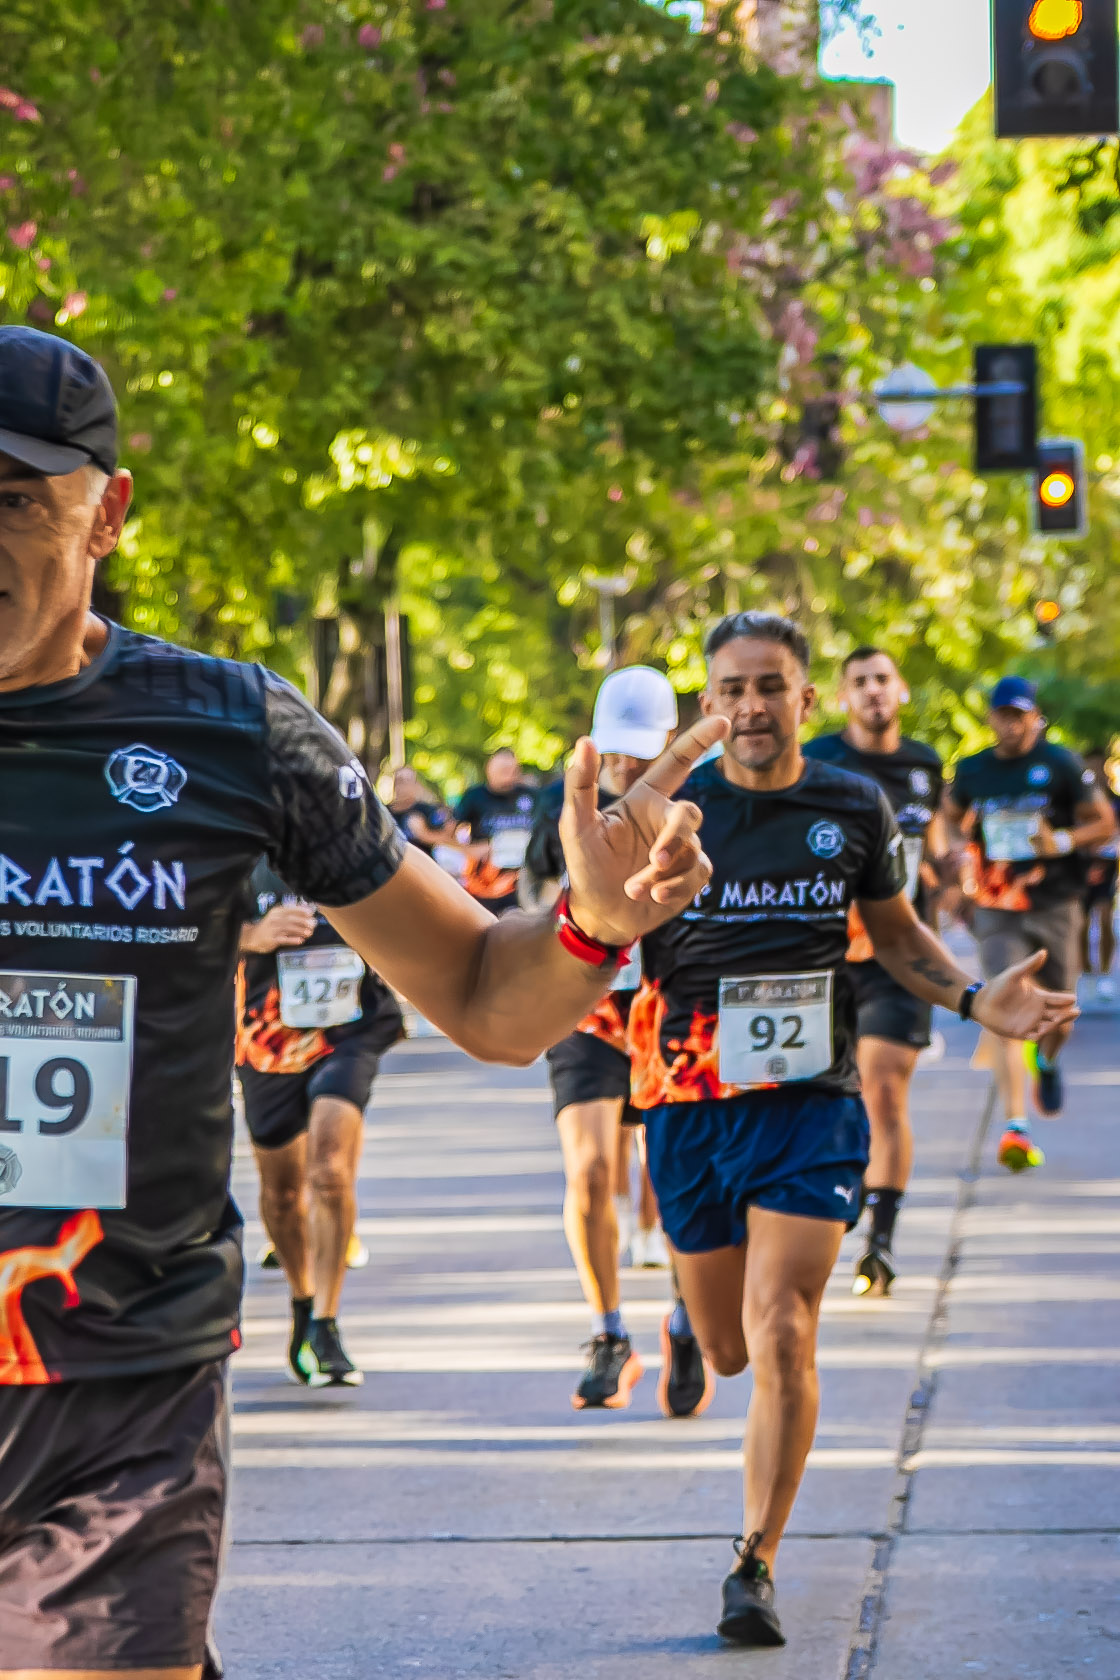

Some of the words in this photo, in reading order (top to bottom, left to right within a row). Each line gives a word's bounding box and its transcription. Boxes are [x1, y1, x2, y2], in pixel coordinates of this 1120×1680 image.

[720, 871, 846, 908] MARATÓN
[13, 920, 133, 943] VOLUNTARIOS
[749, 1015, 806, 1052] 92
